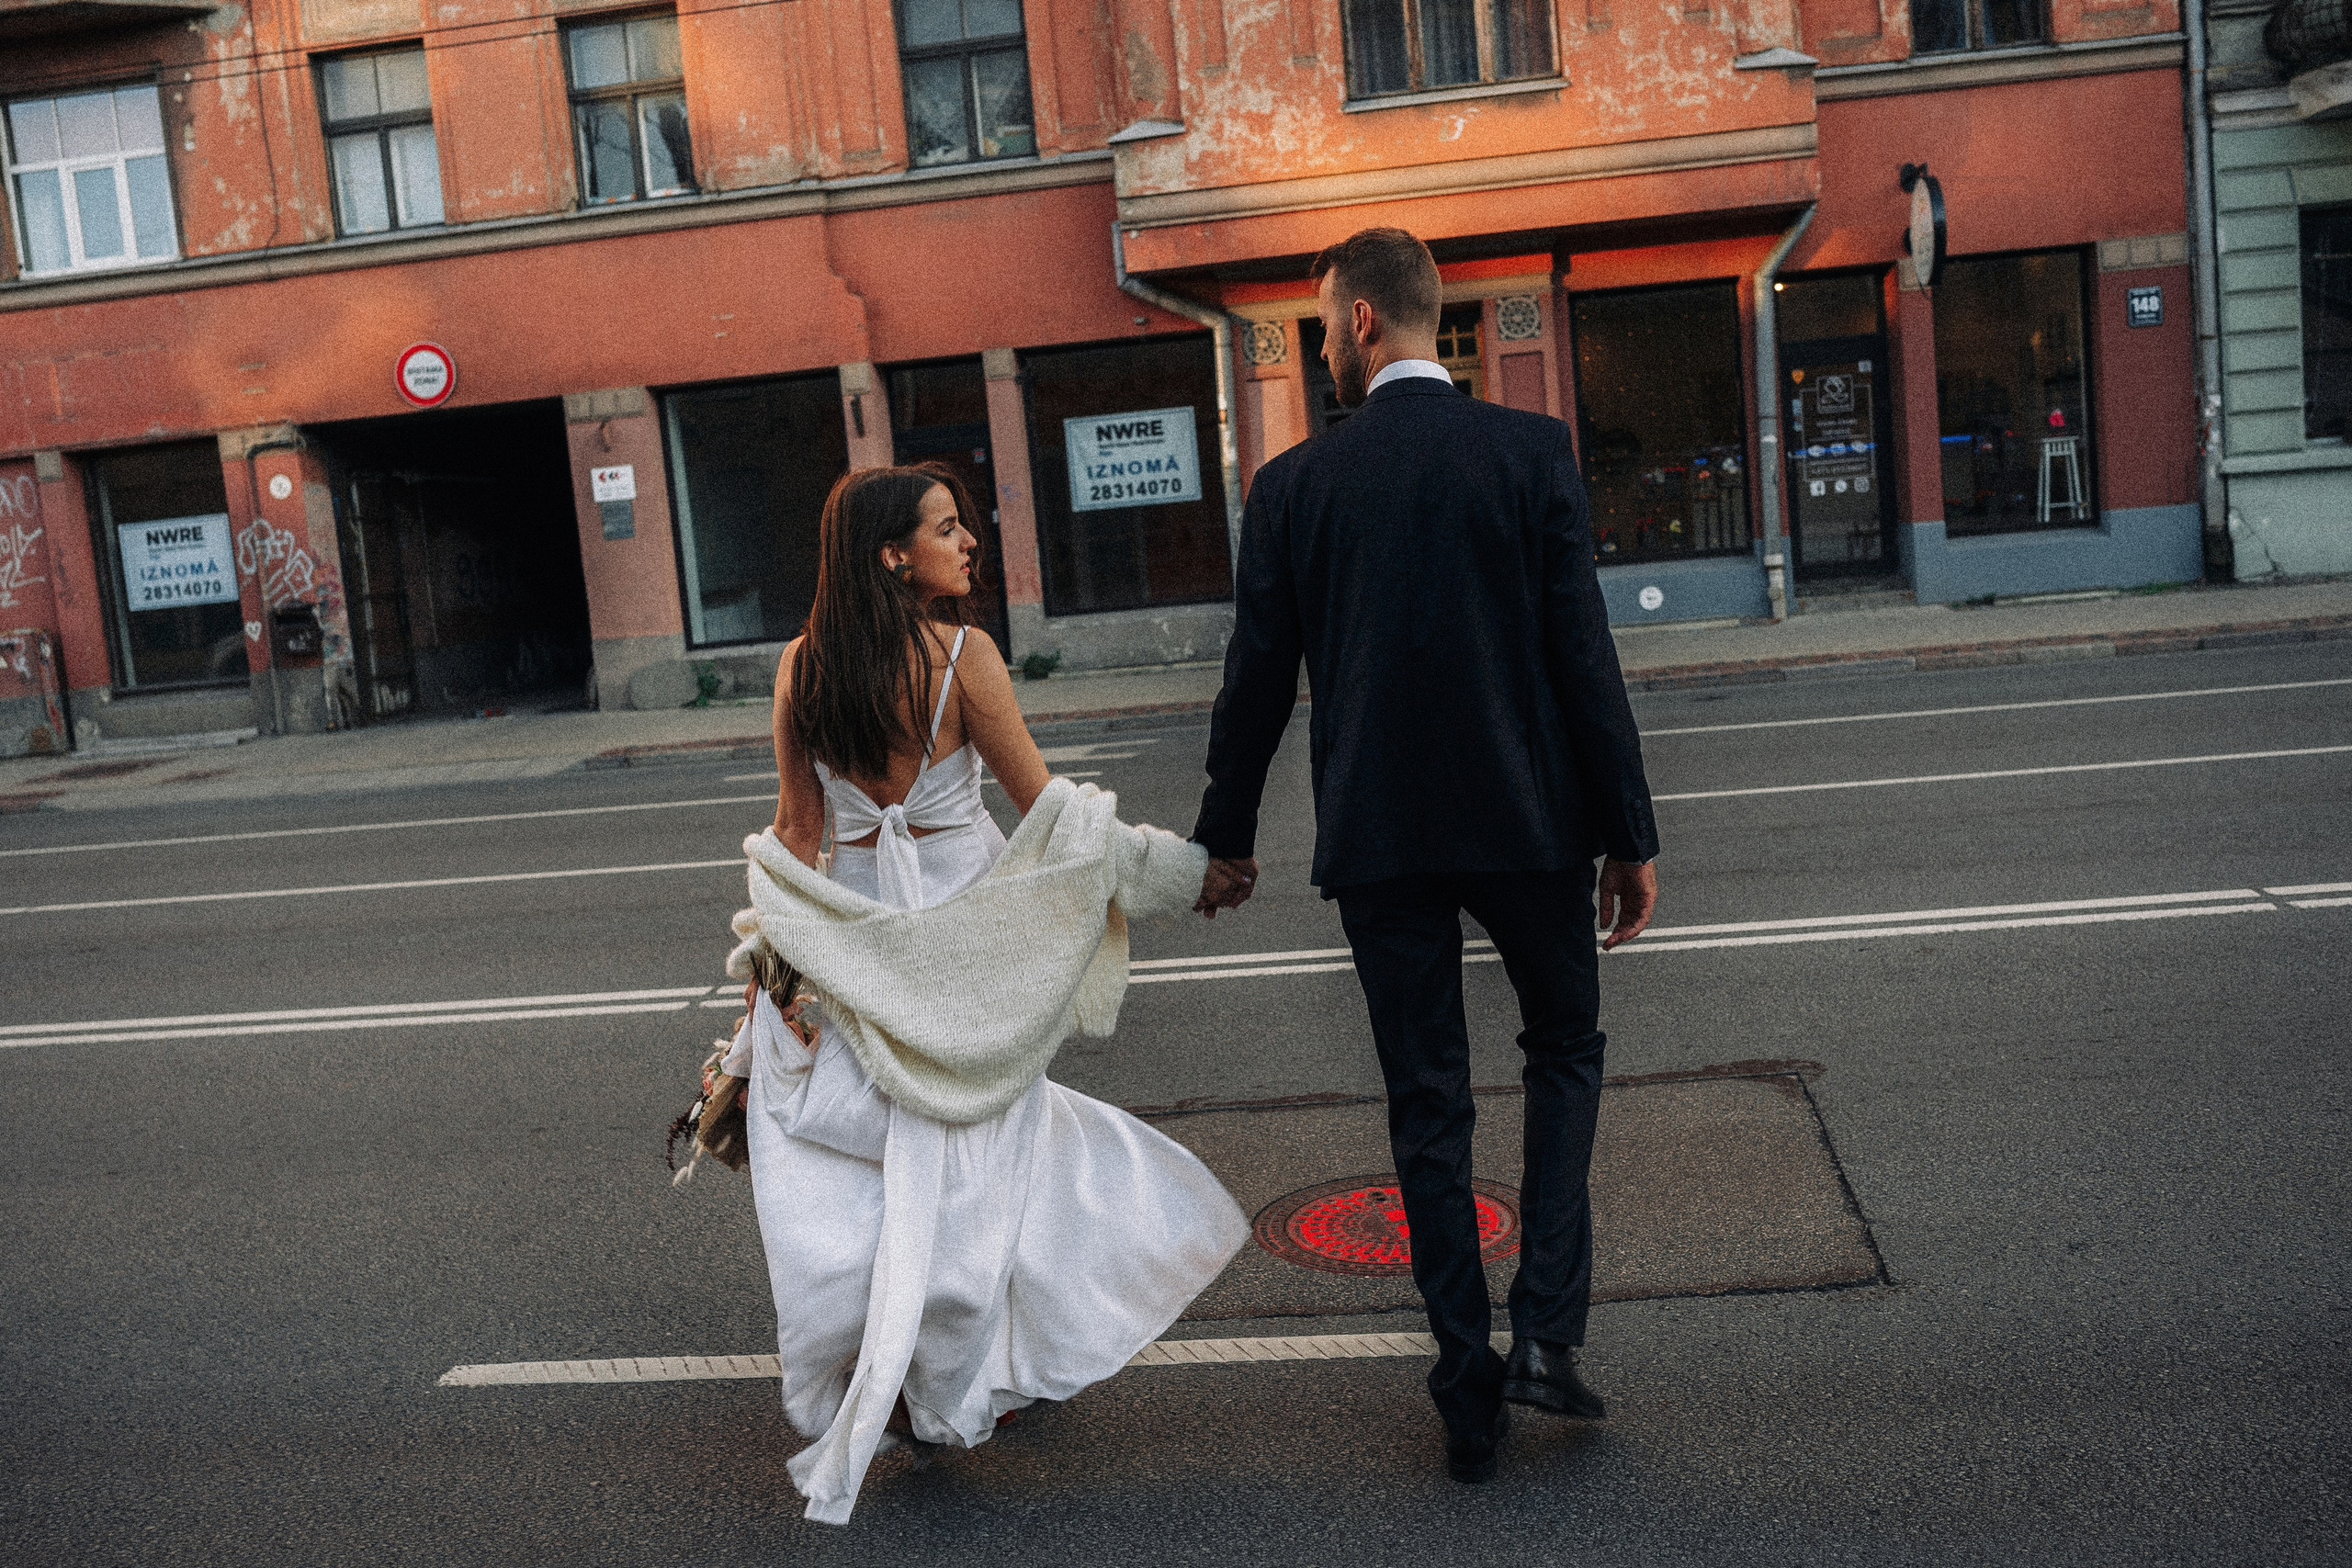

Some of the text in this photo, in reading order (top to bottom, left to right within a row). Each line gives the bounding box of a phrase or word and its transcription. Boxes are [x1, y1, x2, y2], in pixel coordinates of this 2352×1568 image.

[2131, 296, 2160, 313] 148
[1096, 420, 1164, 441] NWRE
[1086, 455, 1180, 479] IZNOMĀ
[1090, 478, 1182, 502] 28314070
[146, 525, 204, 546] NWRE
[142, 581, 222, 601] 28314070
